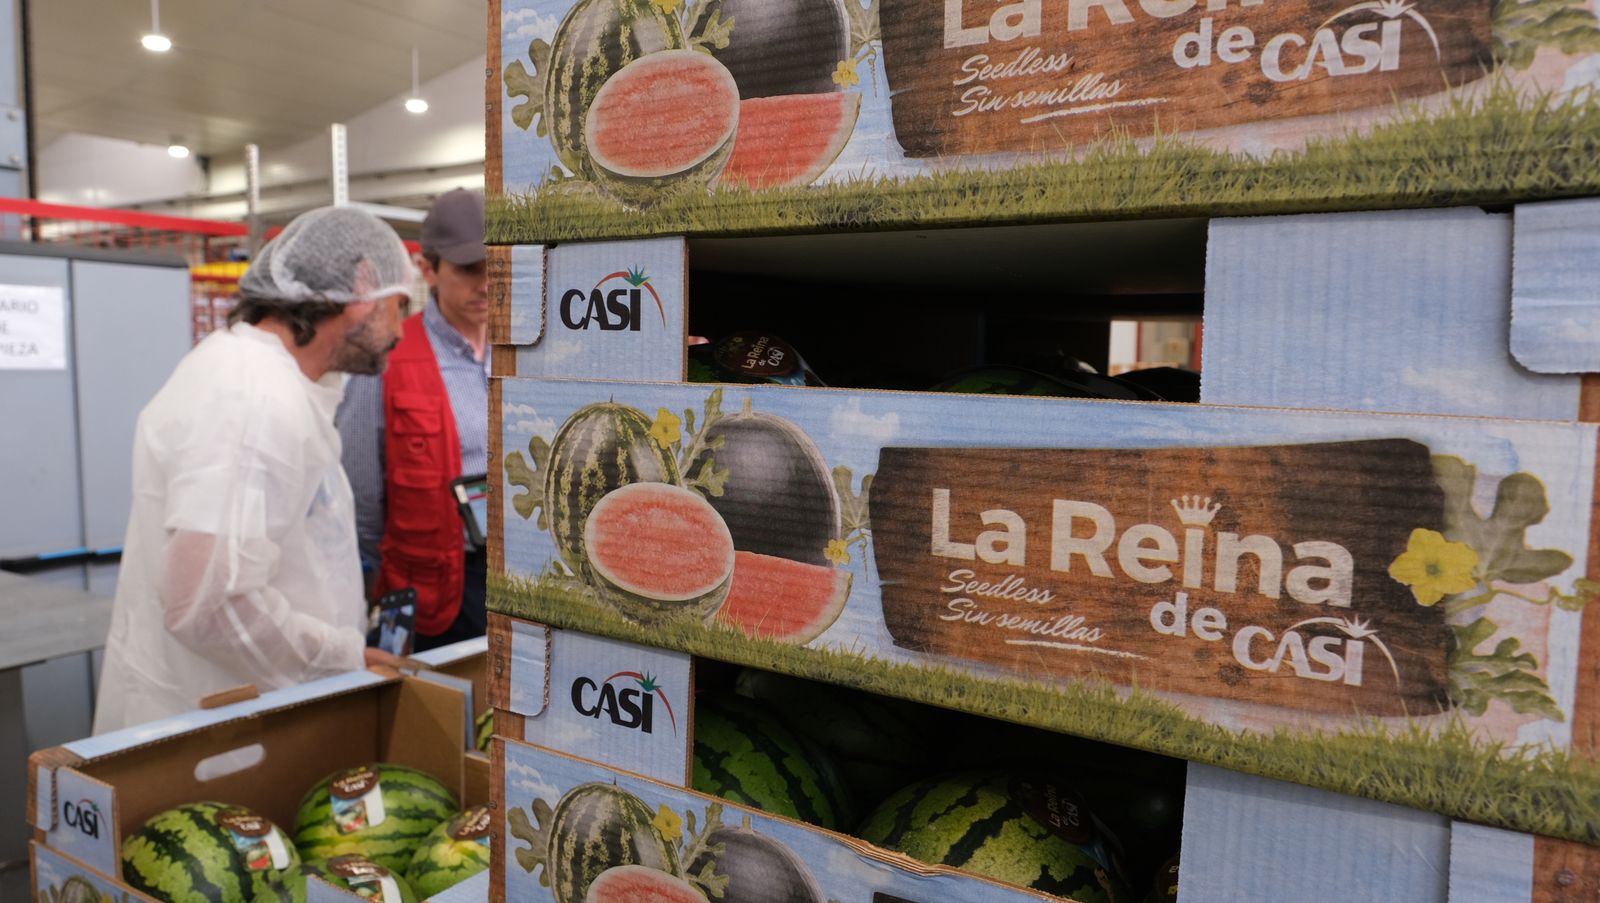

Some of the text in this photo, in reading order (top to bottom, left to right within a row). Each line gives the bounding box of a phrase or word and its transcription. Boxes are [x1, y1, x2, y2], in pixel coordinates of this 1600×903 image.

[943, 0, 1041, 49] La
[953, 47, 1074, 86] Seedless
[1173, 17, 1402, 82] de CASI
[953, 72, 1127, 117] Sin semillas
[560, 289, 641, 331] CASI
[741, 336, 770, 369] La Reina
[767, 348, 785, 367] CASI
[931, 488, 1355, 609] La Reina
[940, 568, 1057, 604] Seedless
[939, 598, 1107, 642] Sin semillas
[1150, 592, 1365, 686] de CASI
[571, 676, 654, 734] CASI
[64, 801, 98, 839] CASI
